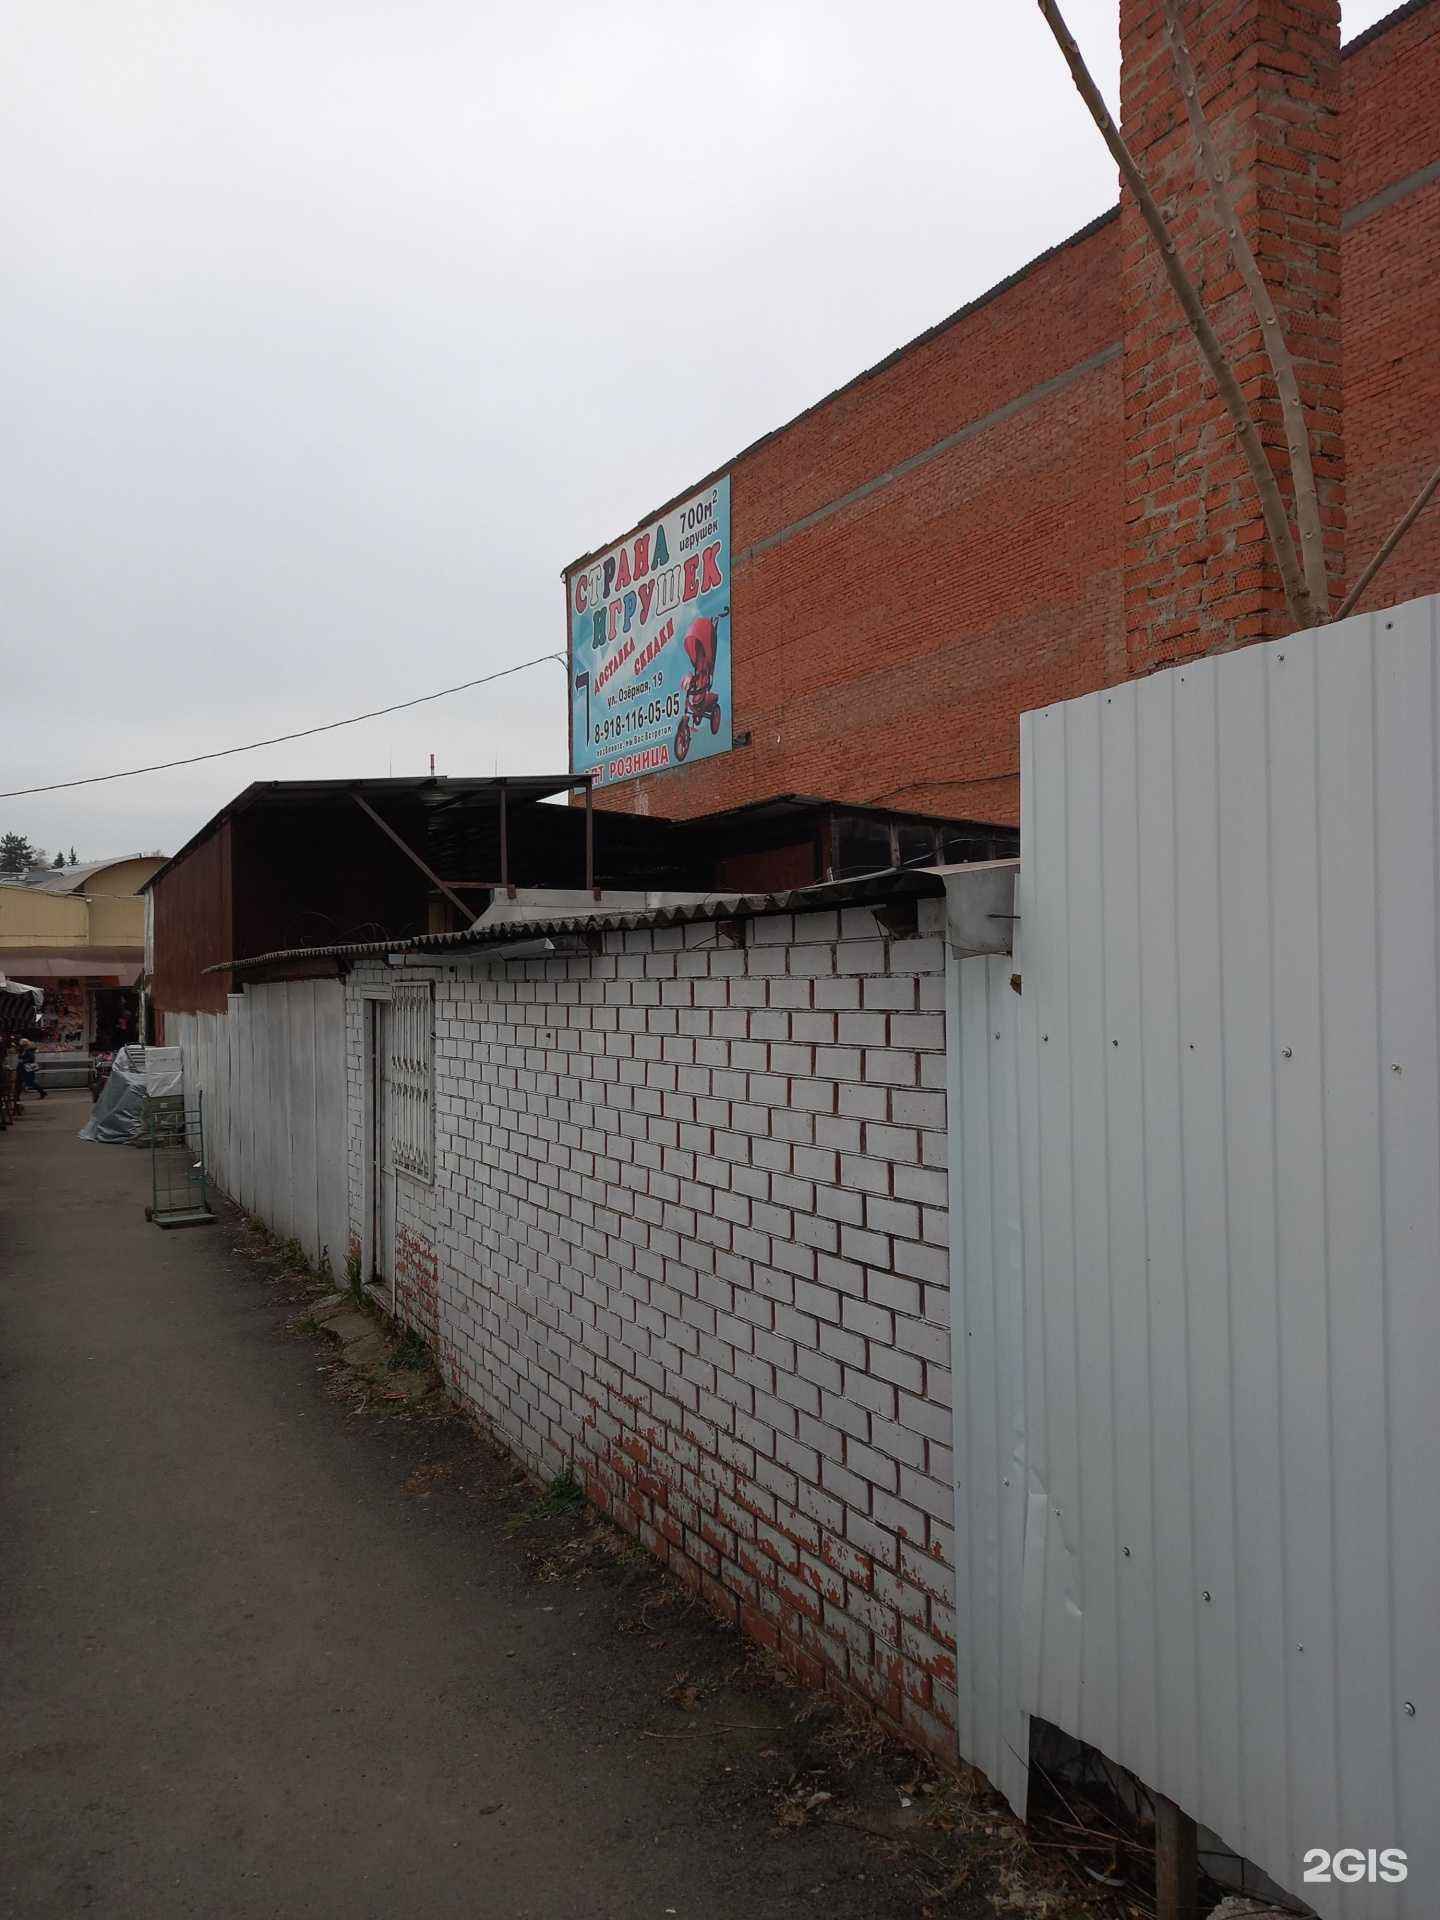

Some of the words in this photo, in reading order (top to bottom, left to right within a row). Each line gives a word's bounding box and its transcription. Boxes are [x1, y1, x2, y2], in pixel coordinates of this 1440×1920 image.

[679, 520, 718, 551] игрушек
[575, 524, 670, 613] СТРАНА
[592, 541, 722, 649] ИГРУШЕК
[594, 637, 636, 696] ДОСТАВКА
[634, 617, 674, 676] СКИДКИ
[607, 695, 617, 709] ул.
[653, 672, 663, 688] 19
[594, 693, 680, 744] 8-918-116-05-05
[585, 766, 604, 784] ПТ
[609, 745, 670, 779] РОЗНИЦА
